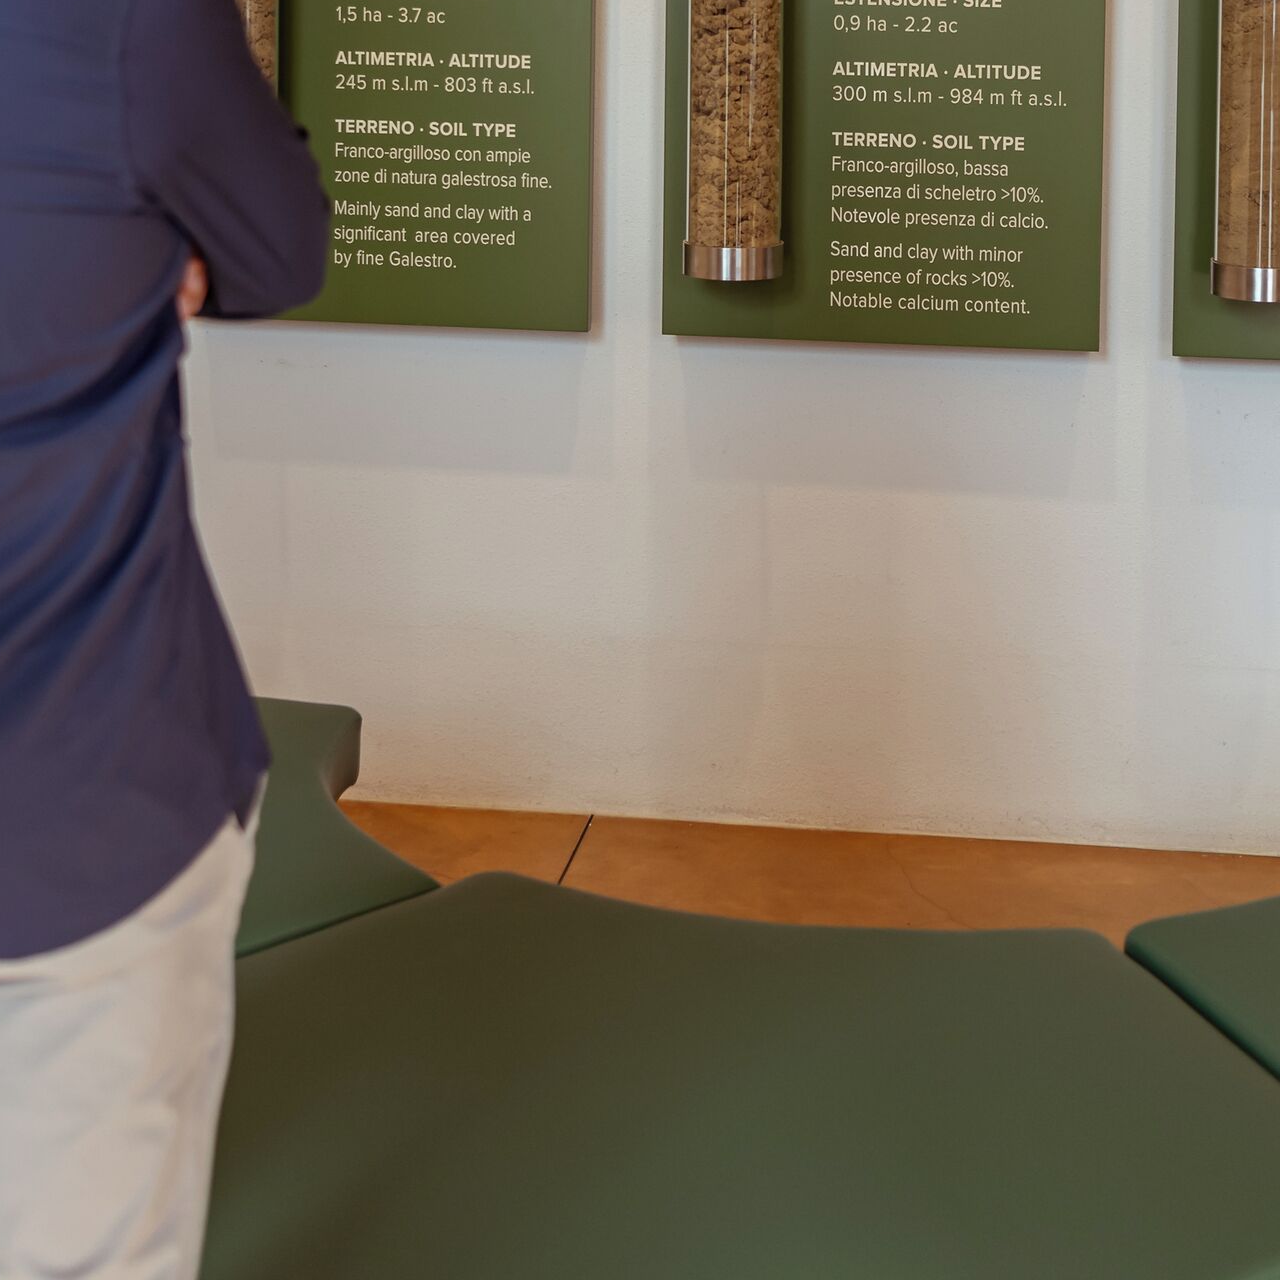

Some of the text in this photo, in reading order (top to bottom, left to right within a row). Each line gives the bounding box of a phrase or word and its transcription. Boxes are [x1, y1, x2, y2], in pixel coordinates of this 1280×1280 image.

[335, 6, 422, 23] 1,5 ha 3.7
[833, 15, 932, 32] 0,9 ha 2.2
[334, 51, 531, 69] ALTIMETRIA ALTITUDE
[832, 62, 1042, 80] ALTIMETRIA ALTITUDE
[335, 74, 535, 94] 245 s.l.m 803 ft a.s.l.
[832, 86, 1067, 106] 300 s.l.m 984 ft a.s.l.
[334, 119, 516, 137] TERRENO SOIL TYPE
[831, 132, 1025, 151] TERRENO SOIL TYPE
[335, 143, 531, 166] Franco-argilloso con ampie
[831, 156, 1009, 177] Franco-argilloso, bassa
[334, 169, 552, 189] zone di natura galestrosa fine.
[831, 184, 1044, 203] presenza di scheletro >10%.
[334, 200, 519, 223] Mainly sand and clay with
[831, 207, 1049, 229] Notevole presenza di calcio.
[333, 225, 516, 245] significant area covered
[335, 249, 457, 268] by fine Galestro.
[830, 241, 1024, 263] Sand and clay with minor
[830, 269, 1015, 287] presence of rocks >10%.
[830, 291, 1030, 314] Notable calcium content.
